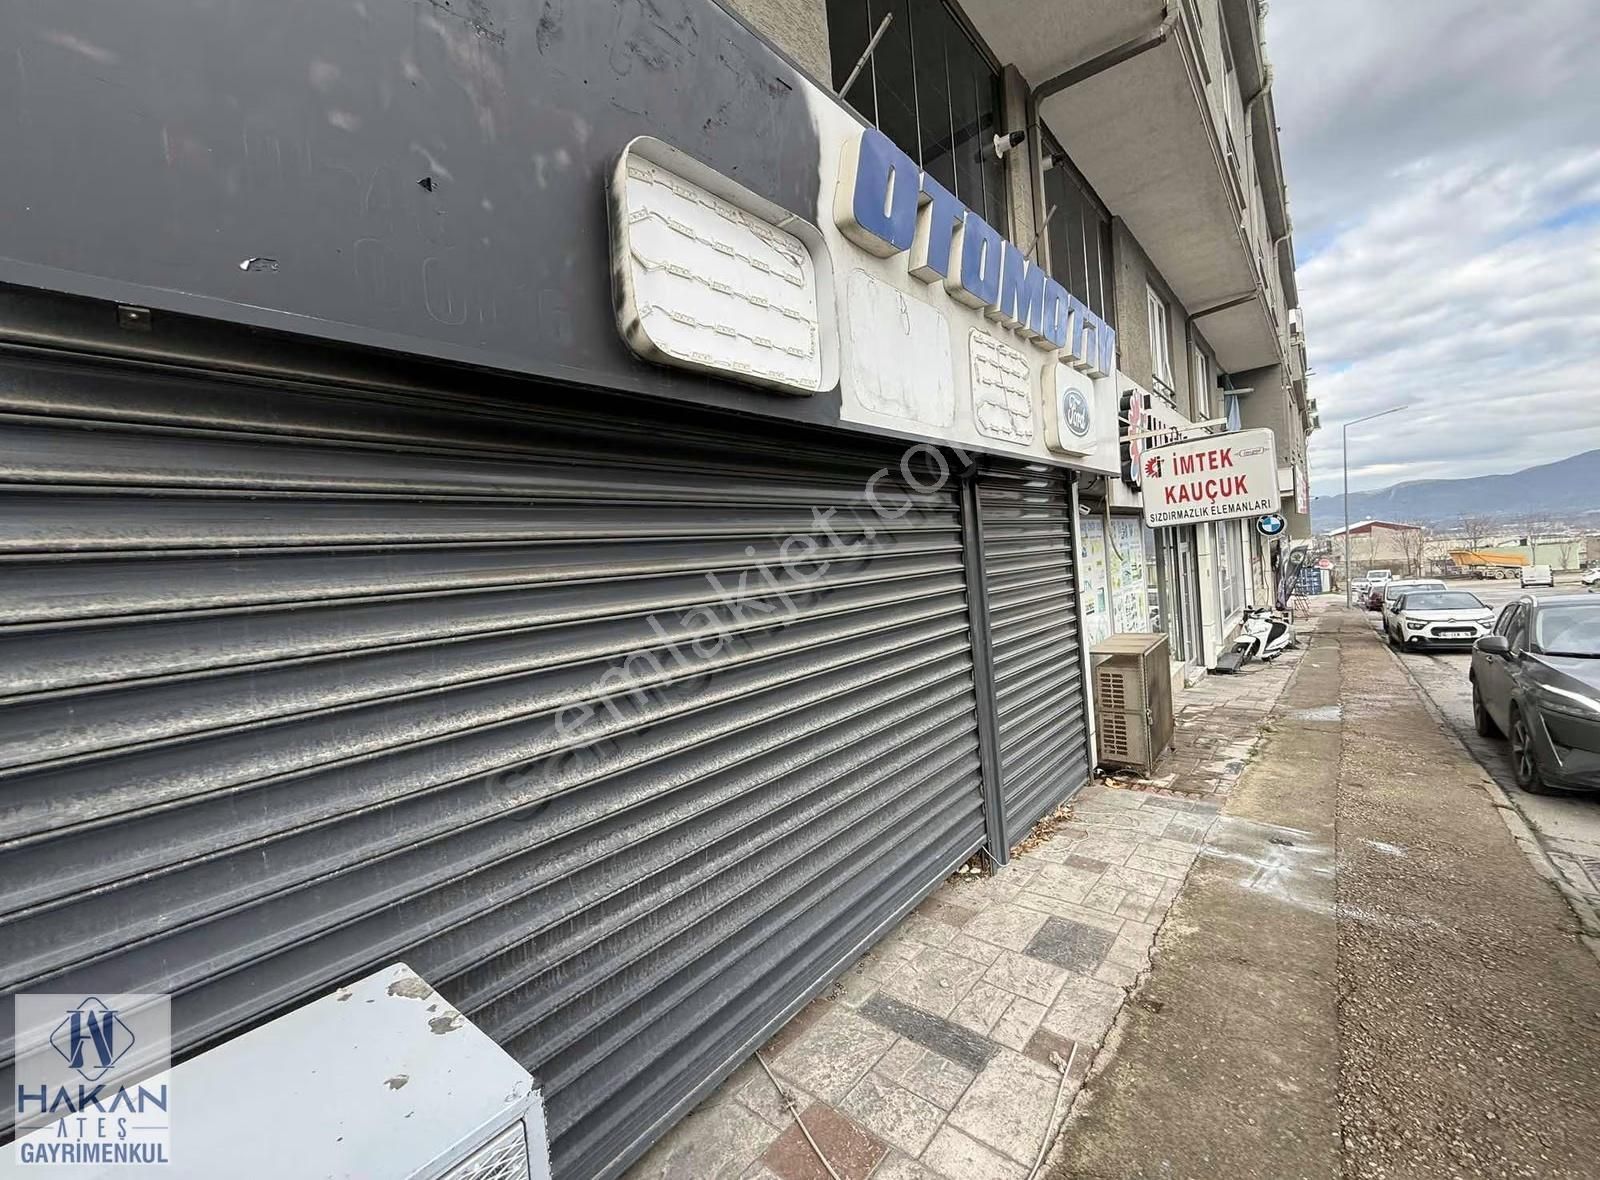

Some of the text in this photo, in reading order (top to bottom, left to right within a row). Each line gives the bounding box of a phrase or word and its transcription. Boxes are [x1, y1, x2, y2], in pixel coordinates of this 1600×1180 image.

[1172, 447, 1234, 476] İMTEK
[1164, 474, 1249, 505] KAUÇUK
[1150, 499, 1271, 523] SIZDIRMAZLIK ELEMANLARI
